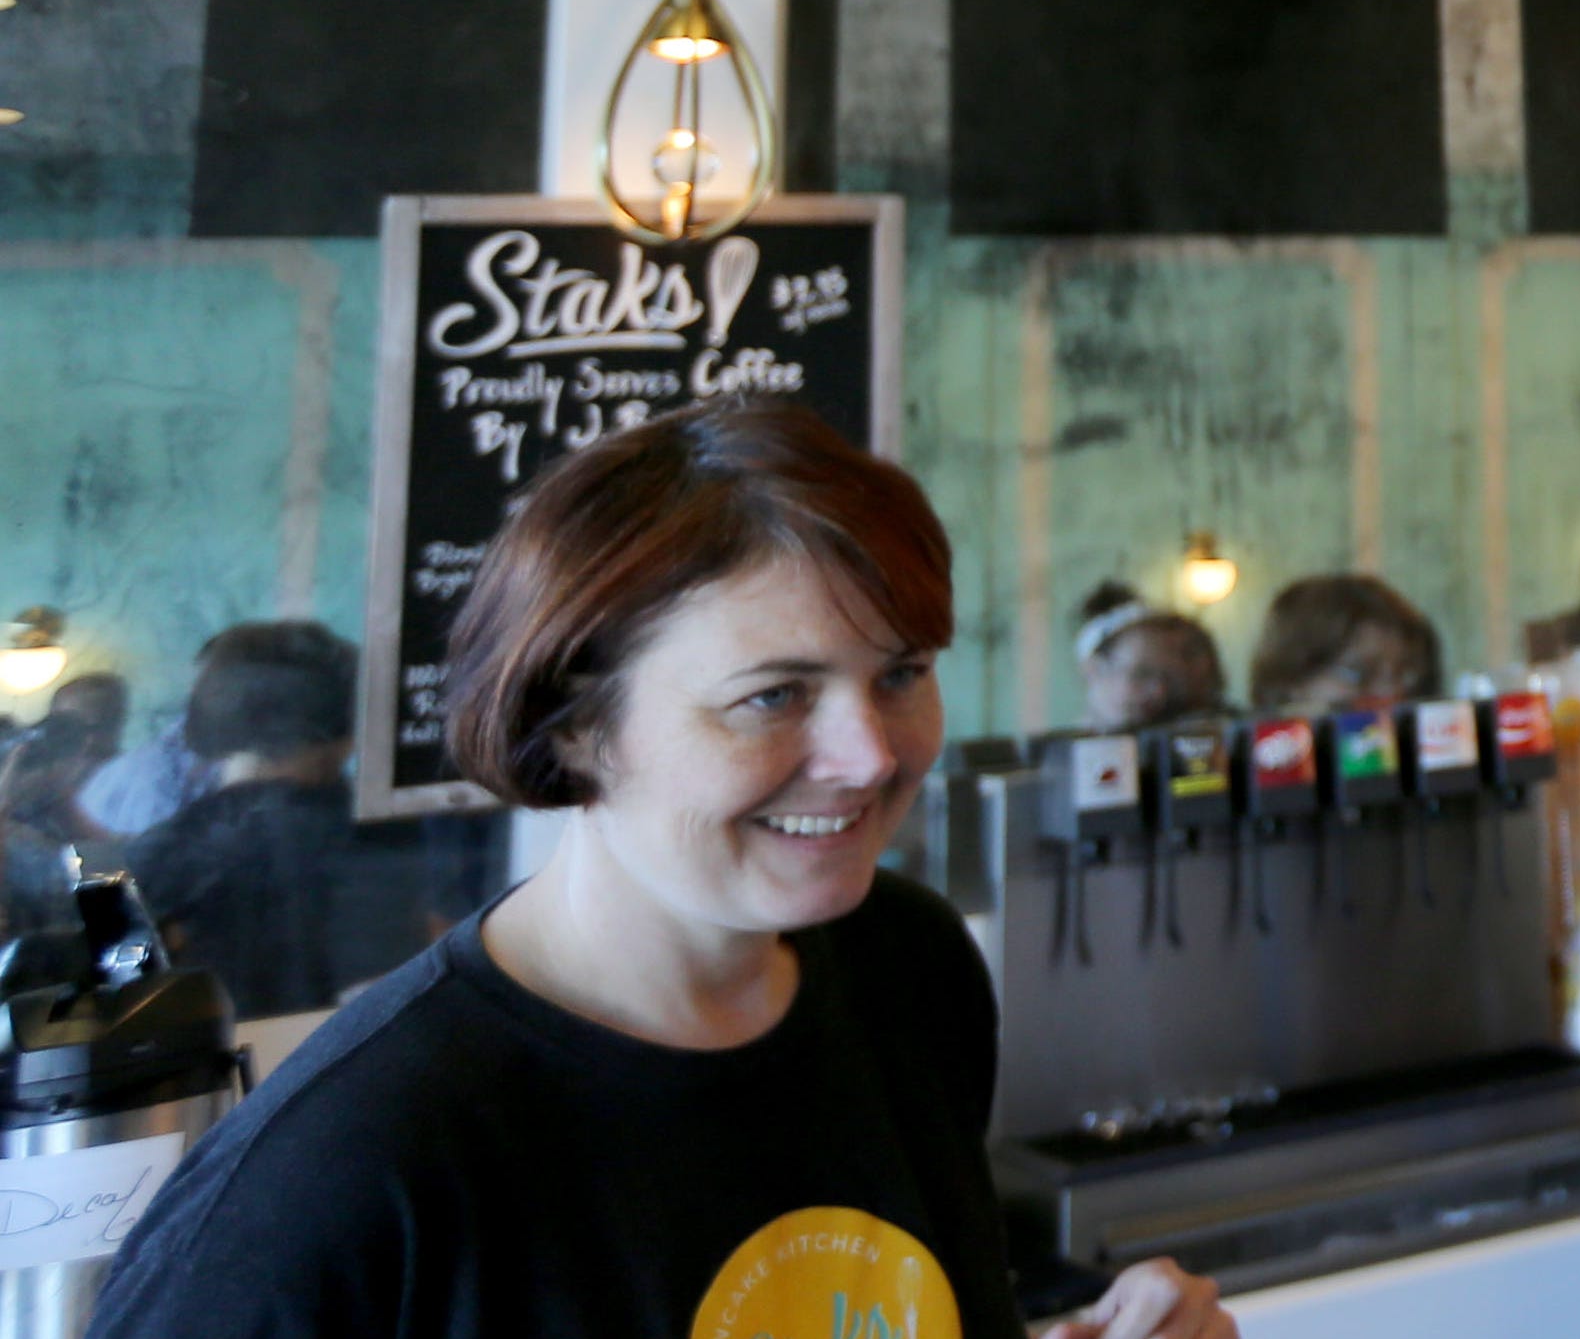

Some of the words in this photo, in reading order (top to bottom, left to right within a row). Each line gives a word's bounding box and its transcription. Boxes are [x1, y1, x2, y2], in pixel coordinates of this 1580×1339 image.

[439, 362, 564, 435] Proudly
[574, 357, 681, 400] Serves
[692, 347, 804, 398] Coffee
[471, 411, 527, 482] By
[774, 1232, 882, 1265] KITCHEN
